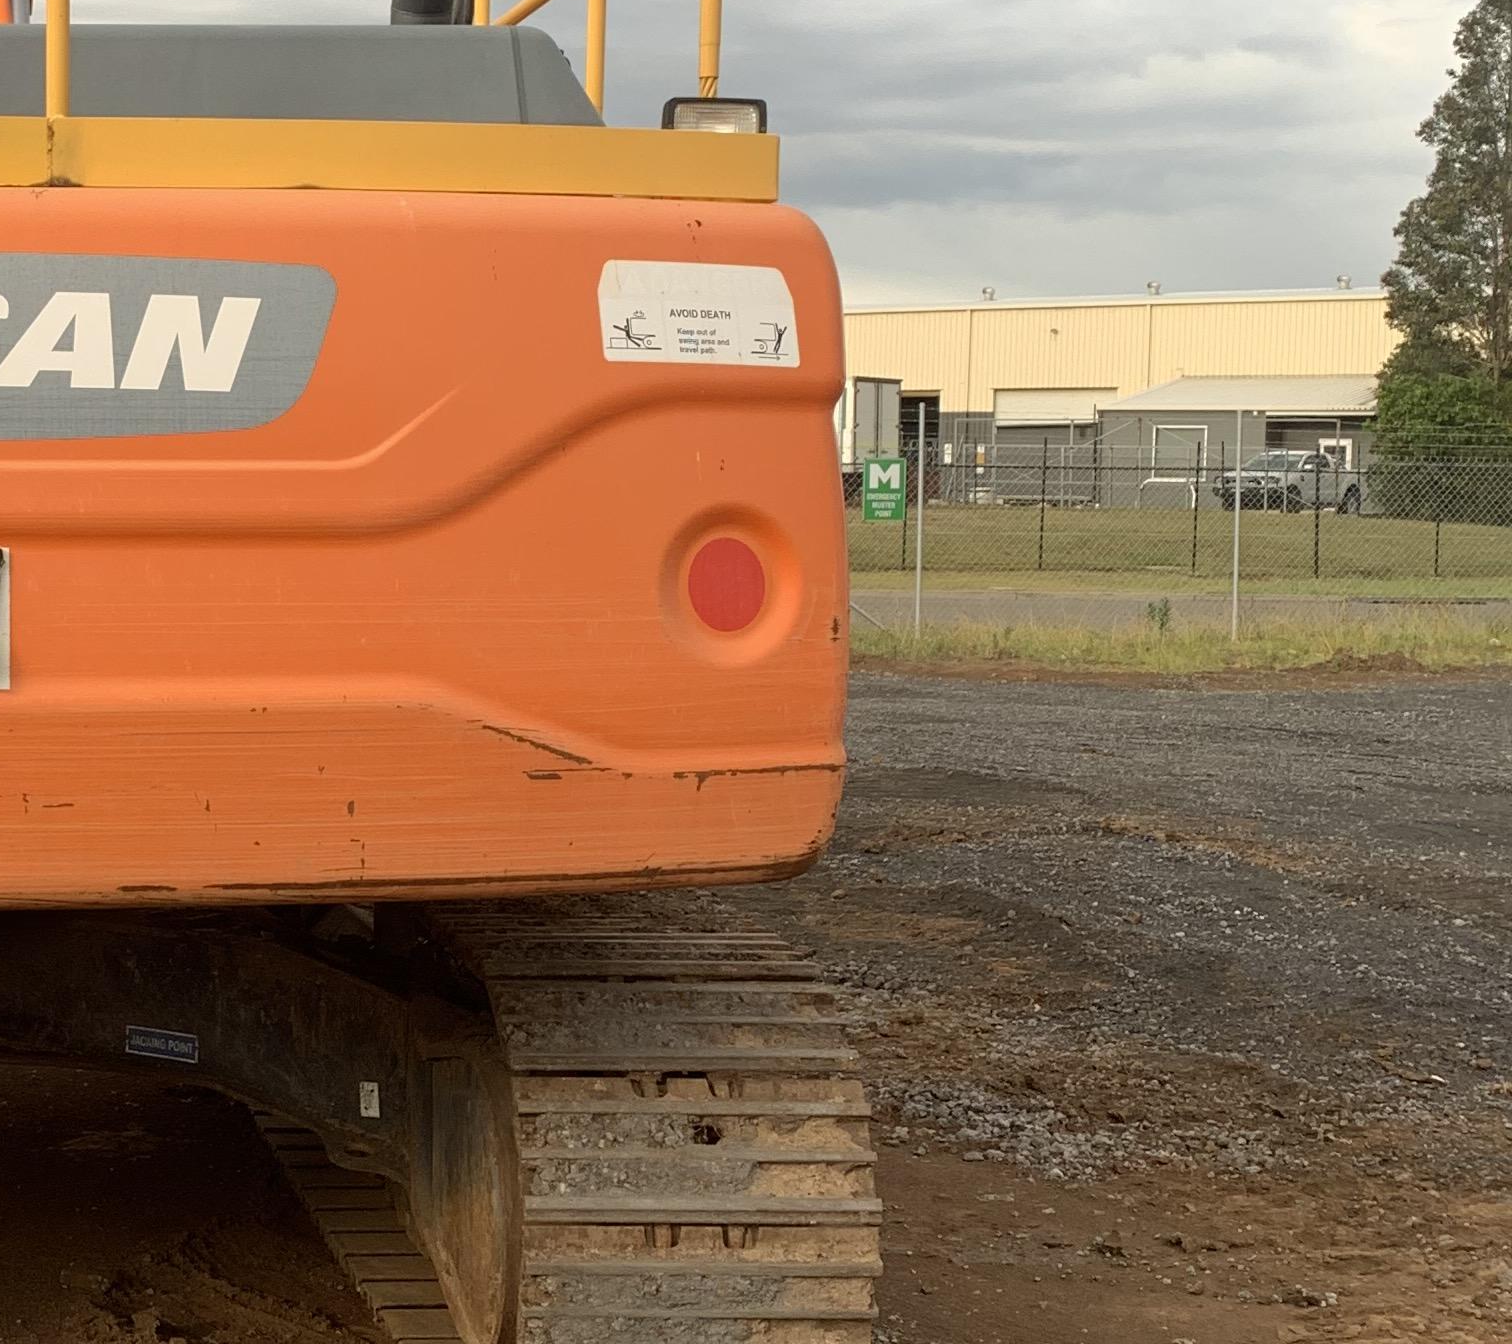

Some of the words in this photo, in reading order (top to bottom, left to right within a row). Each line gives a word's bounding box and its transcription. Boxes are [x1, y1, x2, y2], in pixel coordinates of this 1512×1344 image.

[669, 308, 698, 318] AVOID
[700, 310, 731, 320] DEATH
[676, 327, 695, 337] Keep
[696, 328, 708, 336] out
[869, 463, 901, 489] M
